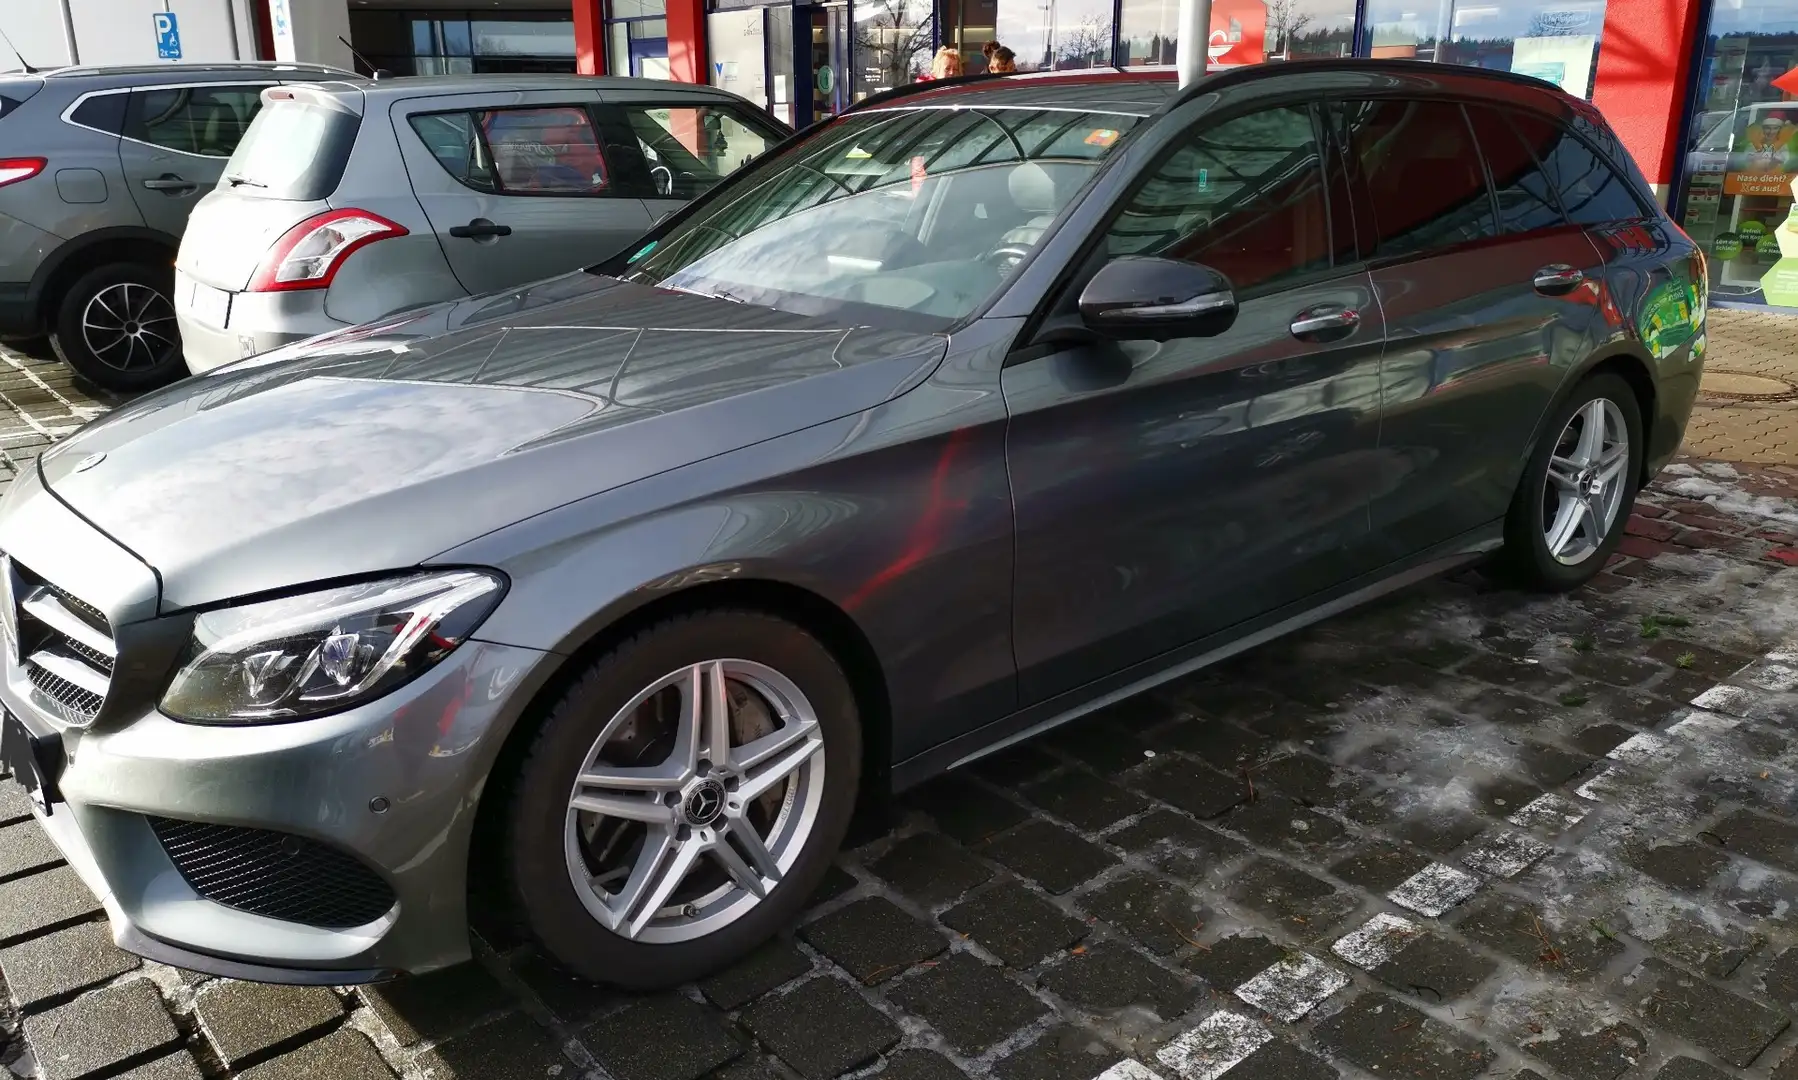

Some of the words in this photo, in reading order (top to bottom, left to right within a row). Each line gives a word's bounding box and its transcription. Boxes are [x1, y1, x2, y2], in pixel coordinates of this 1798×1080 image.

[155, 15, 171, 43] P
[160, 49, 168, 57] 2x
[1737, 174, 1758, 182] Nase
[1760, 174, 1787, 183] dicht?
[1762, 184, 1780, 192] aus!
